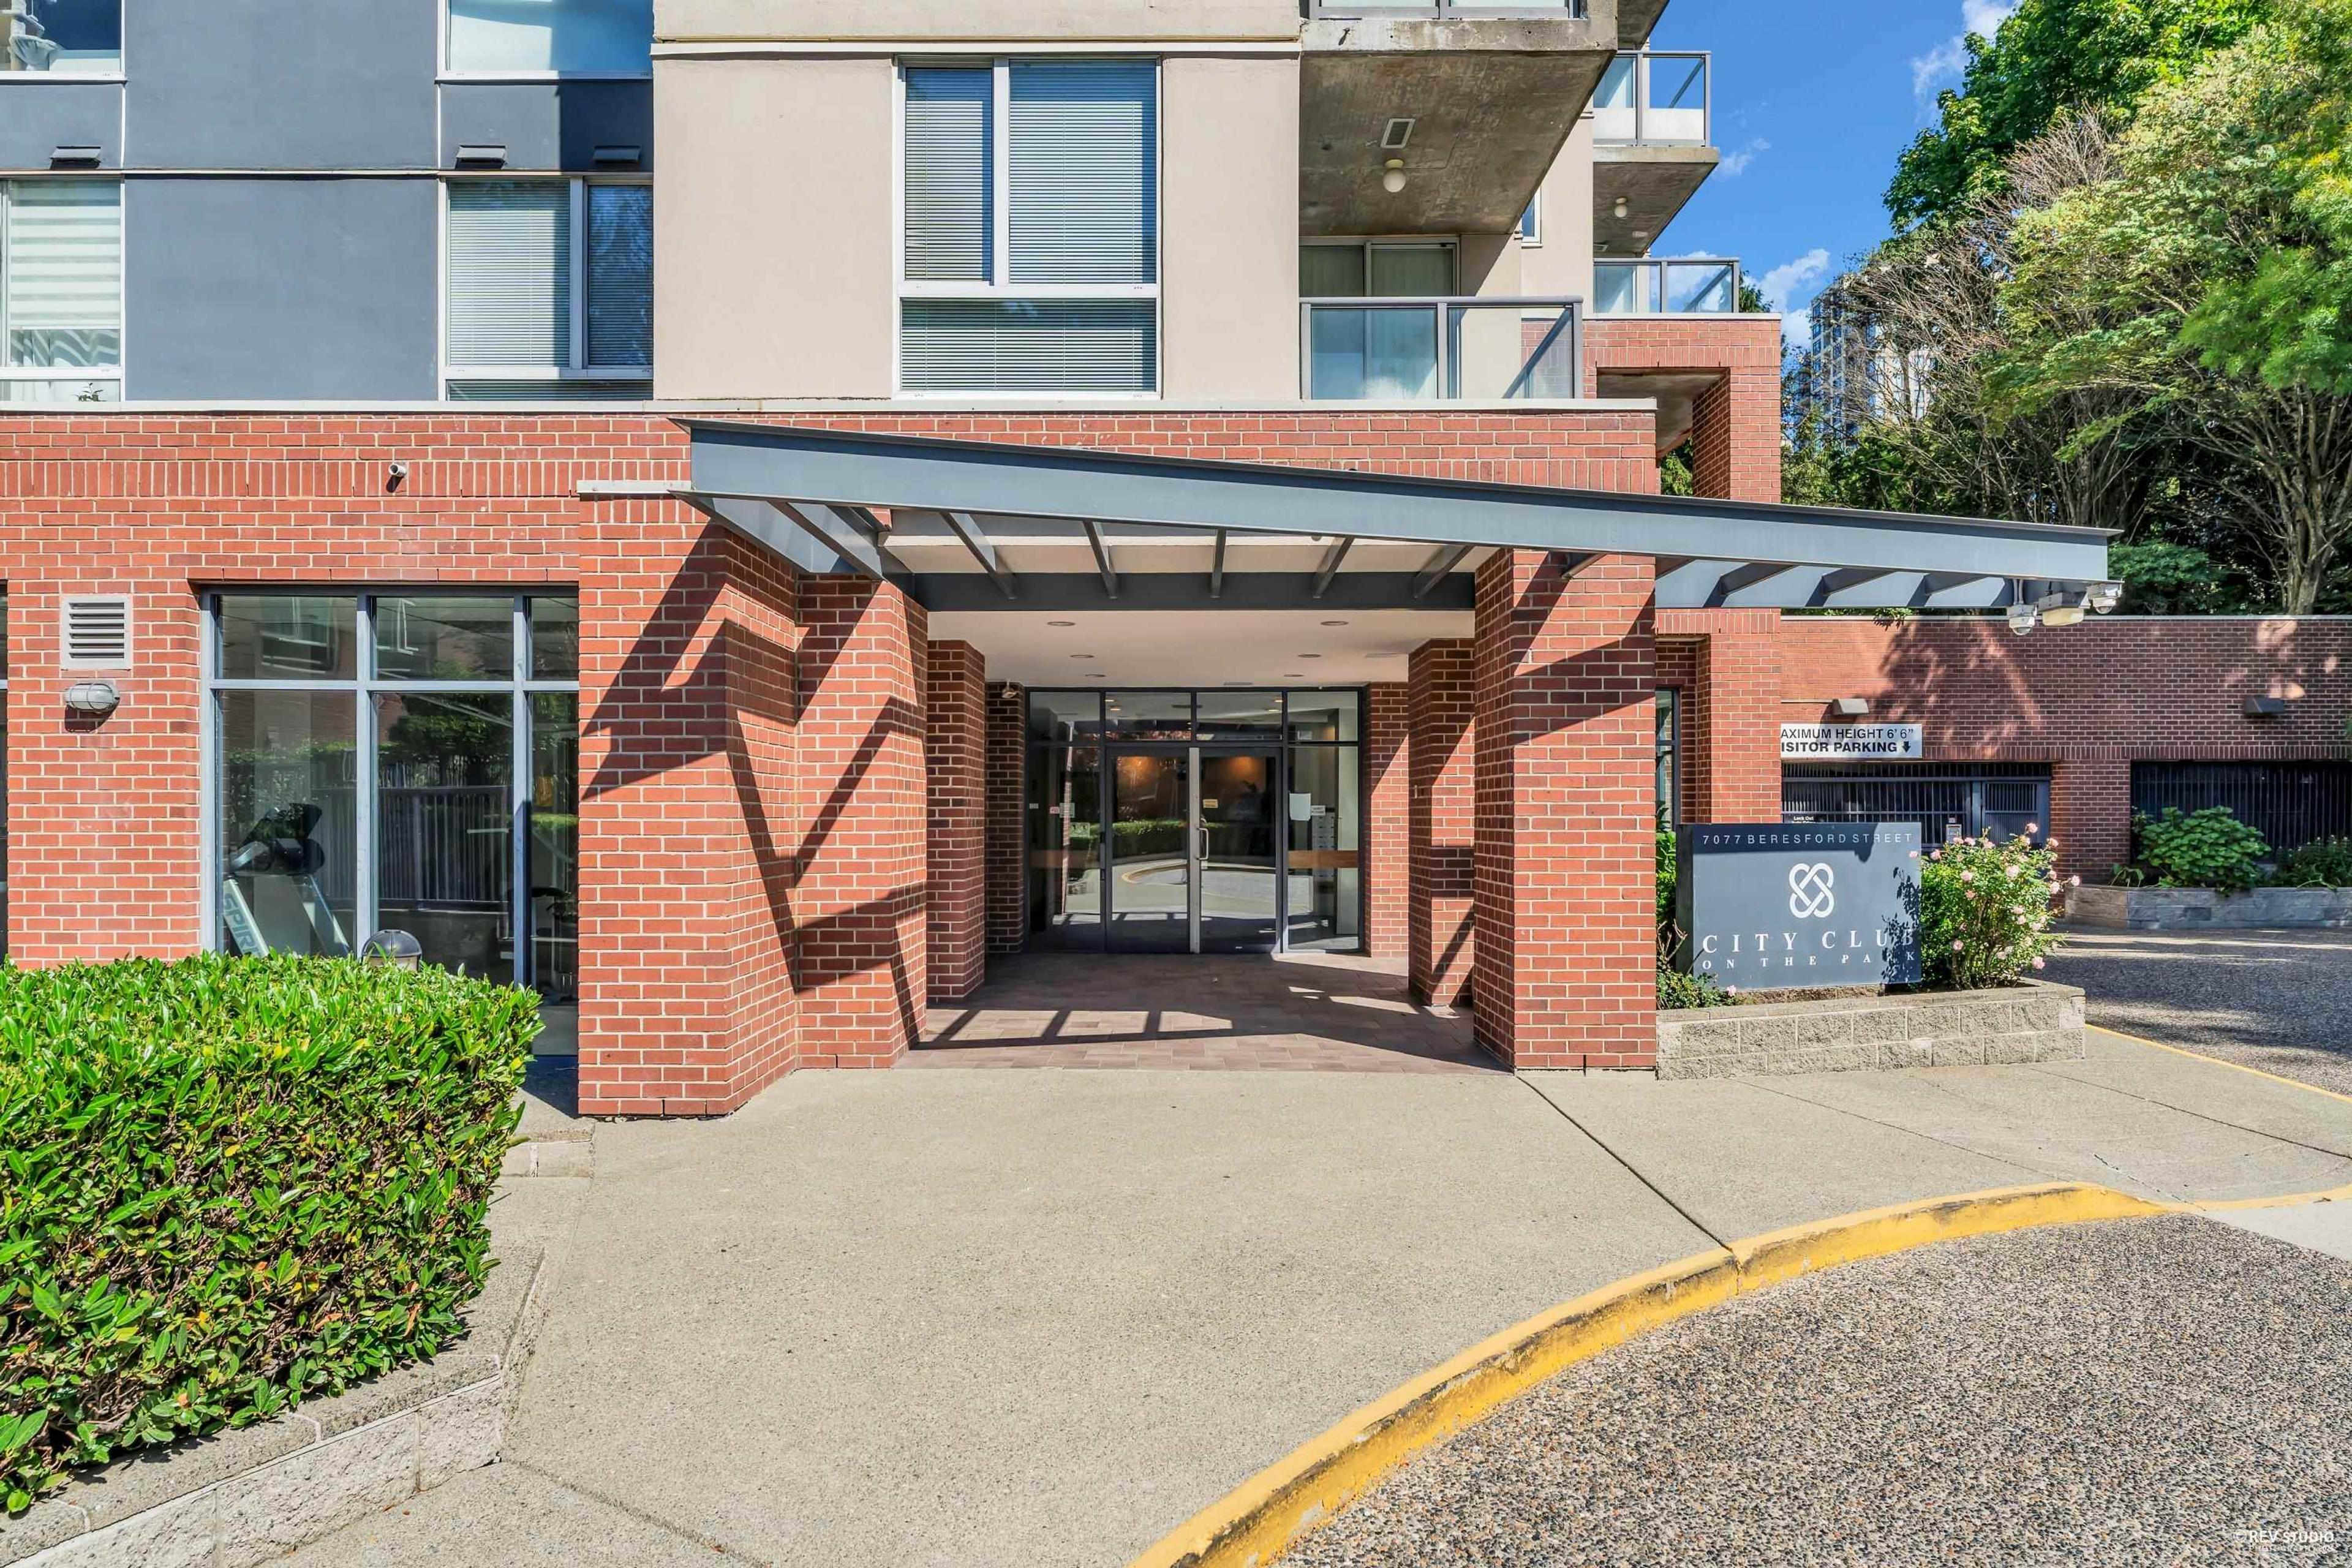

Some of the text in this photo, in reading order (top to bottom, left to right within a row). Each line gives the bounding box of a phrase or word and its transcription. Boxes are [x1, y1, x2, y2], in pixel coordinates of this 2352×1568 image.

[1781, 728, 1831, 739] AXIMUM
[1836, 728, 1883, 739] HEIGHT
[1781, 742, 1898, 752] ISITOR PARKING
[1702, 834, 1912, 845] 7077 BERESFORD STREET
[224, 892, 262, 957] SPIRI
[1702, 929, 1913, 954] CITY CLUB
[1702, 951, 1915, 970] ON THE PARK
